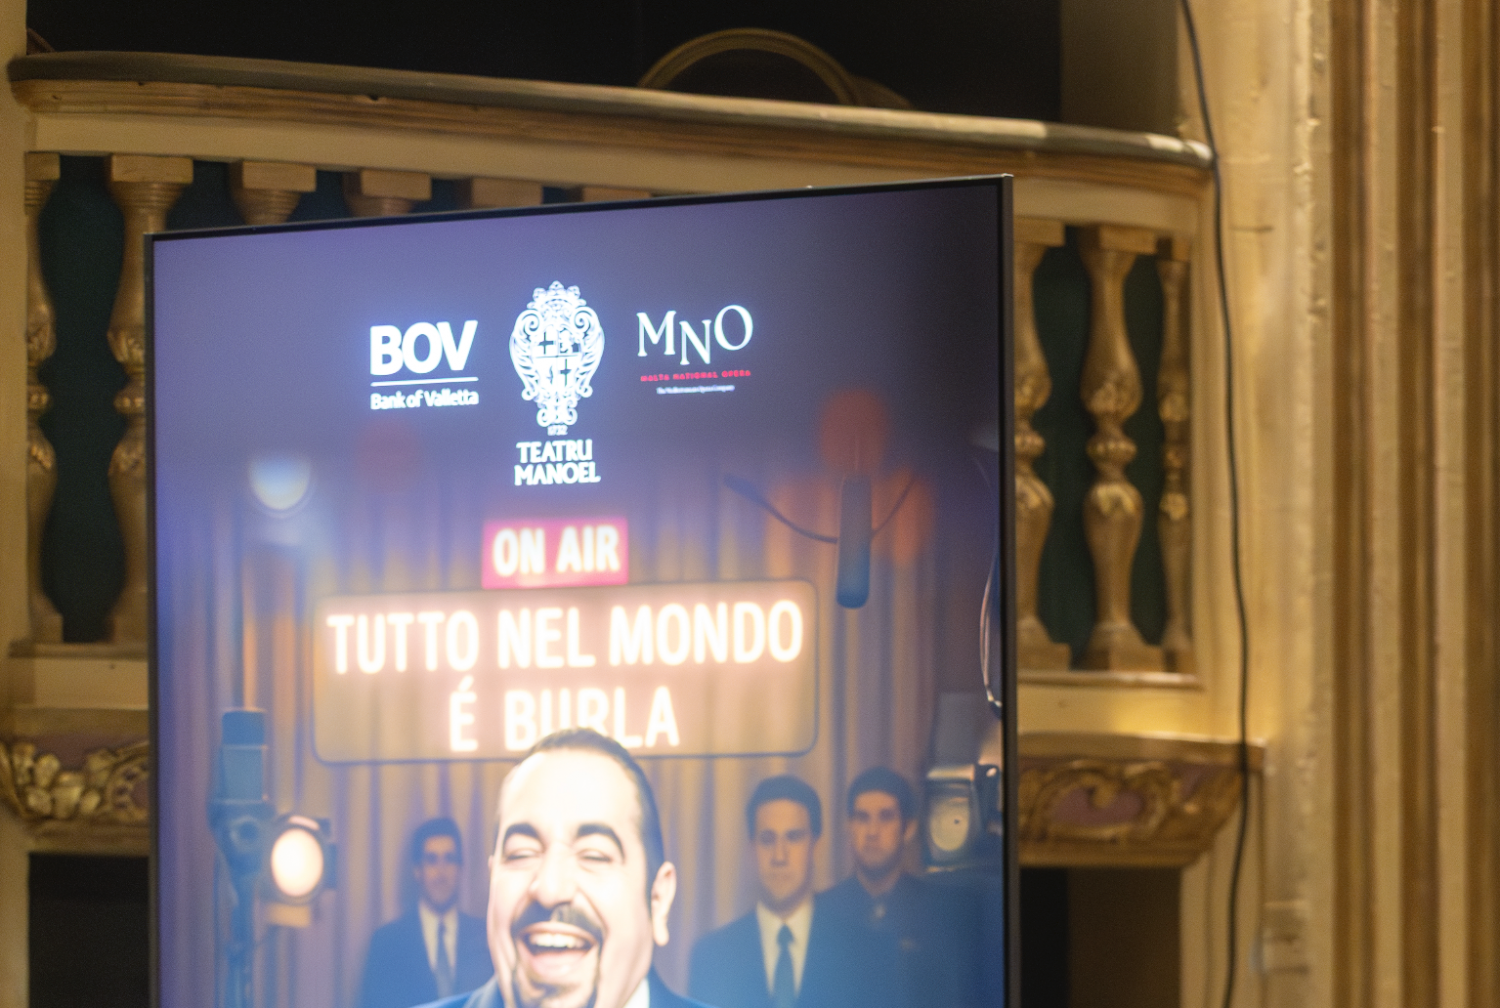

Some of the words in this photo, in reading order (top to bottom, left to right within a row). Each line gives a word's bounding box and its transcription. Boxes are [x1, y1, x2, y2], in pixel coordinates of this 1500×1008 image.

[370, 319, 478, 375] BOV
[637, 304, 754, 365] MNO
[722, 369, 751, 378] OPERA
[370, 390, 406, 410] Bank
[406, 388, 424, 408] of
[423, 388, 479, 407] Valletta
[514, 461, 601, 486] MANOEL
[516, 438, 593, 463] TEATRU
[492, 527, 545, 575] ON
[556, 525, 620, 572] AIR
[326, 610, 479, 674] TUTTO
[497, 607, 596, 669] NEL
[608, 600, 803, 666] MONDO
[449, 676, 478, 752] É
[504, 686, 680, 750] BURLA
